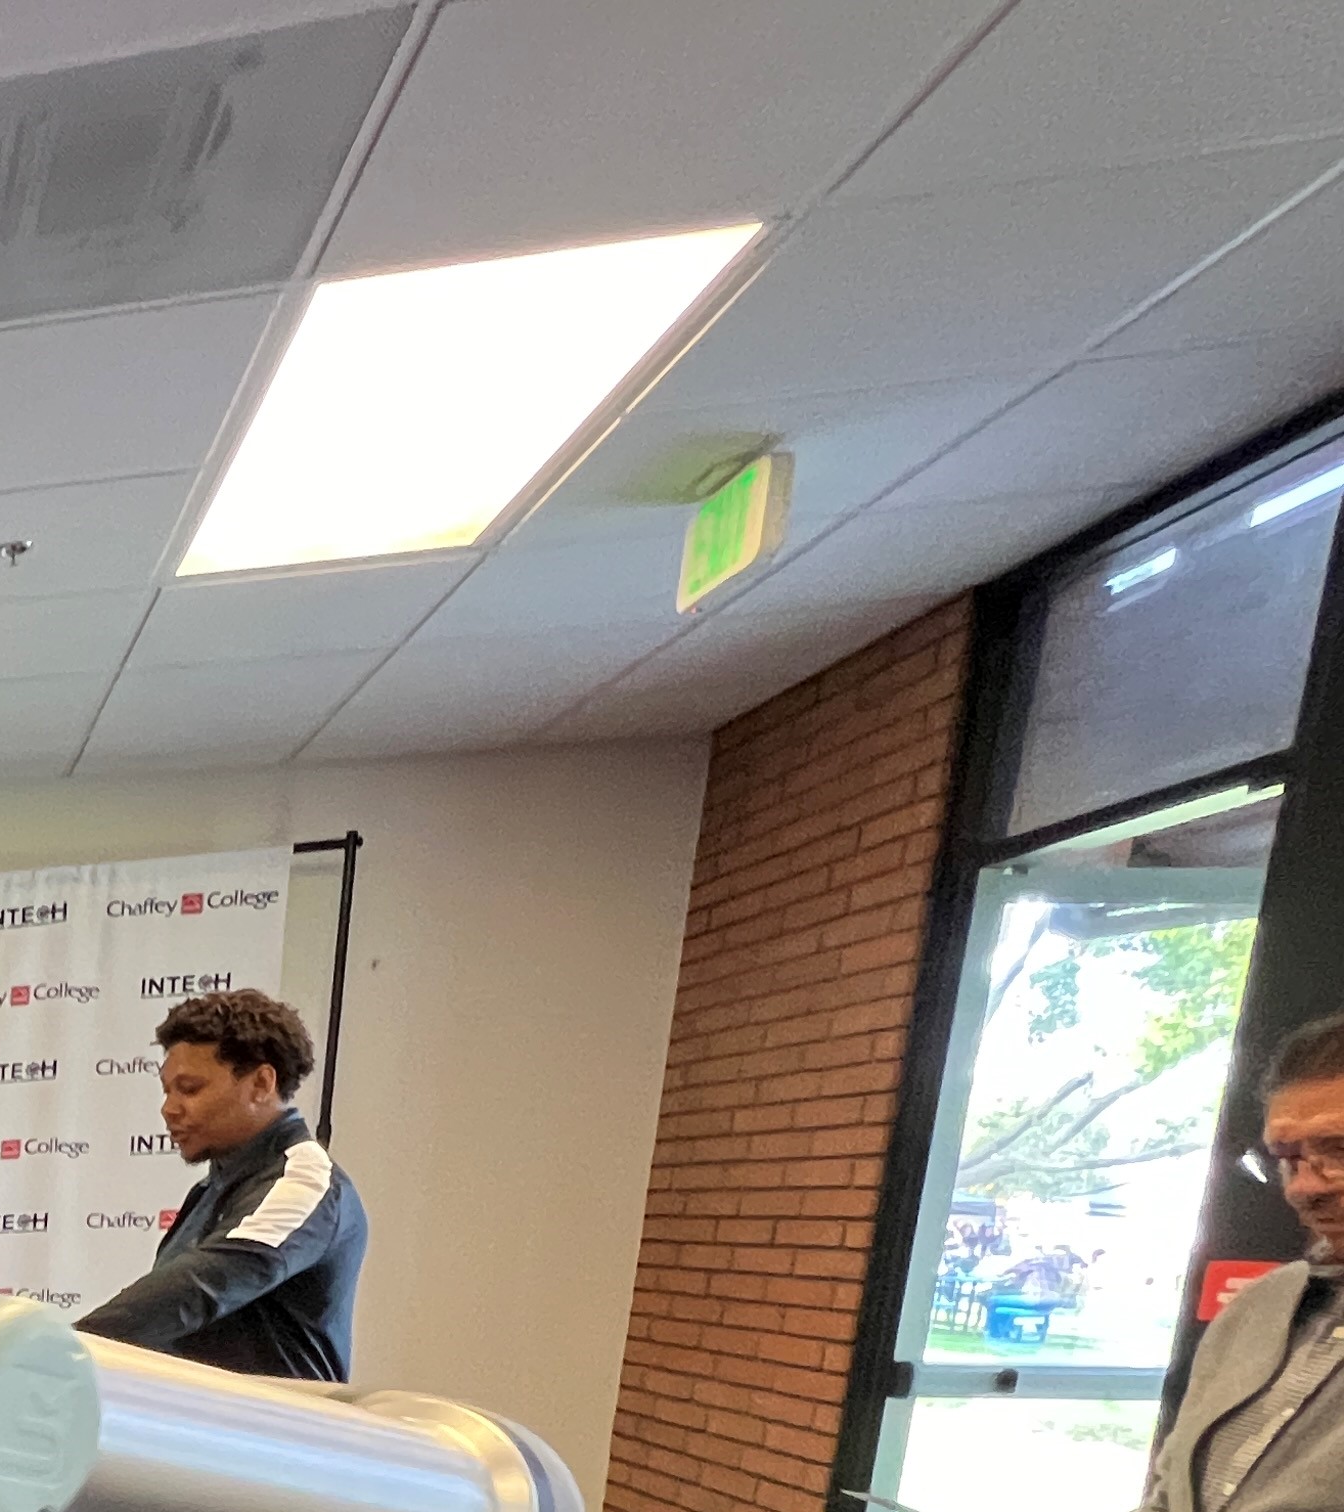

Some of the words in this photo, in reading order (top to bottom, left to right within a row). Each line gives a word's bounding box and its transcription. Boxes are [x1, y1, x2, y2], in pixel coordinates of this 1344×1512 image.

[107, 896, 178, 918] Chaffey
[207, 889, 279, 910] College
[34, 981, 100, 1004] College
[25, 1138, 90, 1159] College
[86, 1211, 155, 1232] Chaffey
